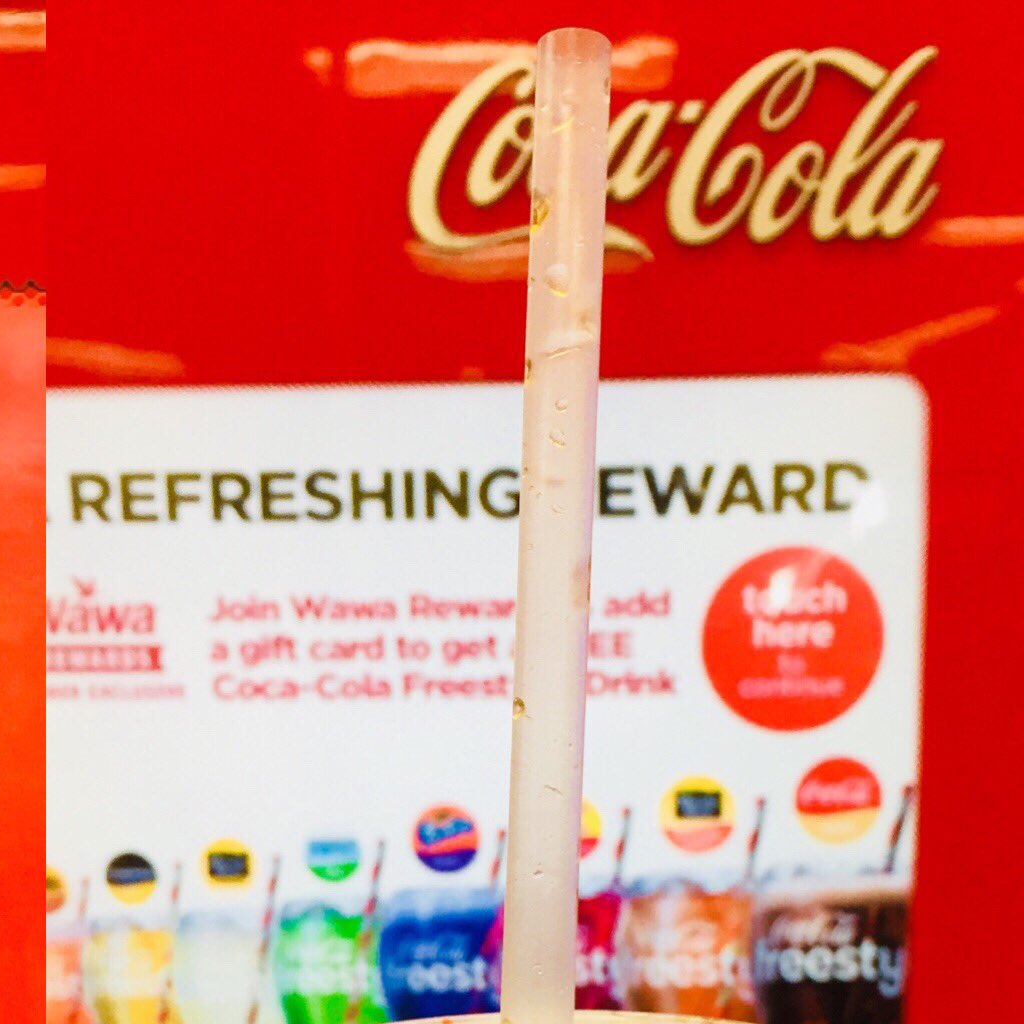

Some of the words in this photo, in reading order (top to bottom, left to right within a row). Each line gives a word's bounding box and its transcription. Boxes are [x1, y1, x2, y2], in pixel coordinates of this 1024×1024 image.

[408, 45, 942, 258] Coa-Cola
[69, 468, 521, 523] REFRESHING
[598, 463, 869, 519] EWARD
[211, 596, 281, 623] Join
[290, 595, 398, 622] Wawa
[408, 592, 517, 620] Rewar
[603, 589, 672, 619] add
[741, 580, 849, 616] touch
[210, 642, 230, 663] a
[238, 633, 297, 667] gift
[309, 633, 386, 662] card
[395, 635, 432, 661] to
[441, 633, 498, 666] get
[751, 618, 836, 649] here
[212, 672, 393, 701] Coca-Cola
[401, 671, 510, 698] Freest
[586, 668, 678, 698] Drink
